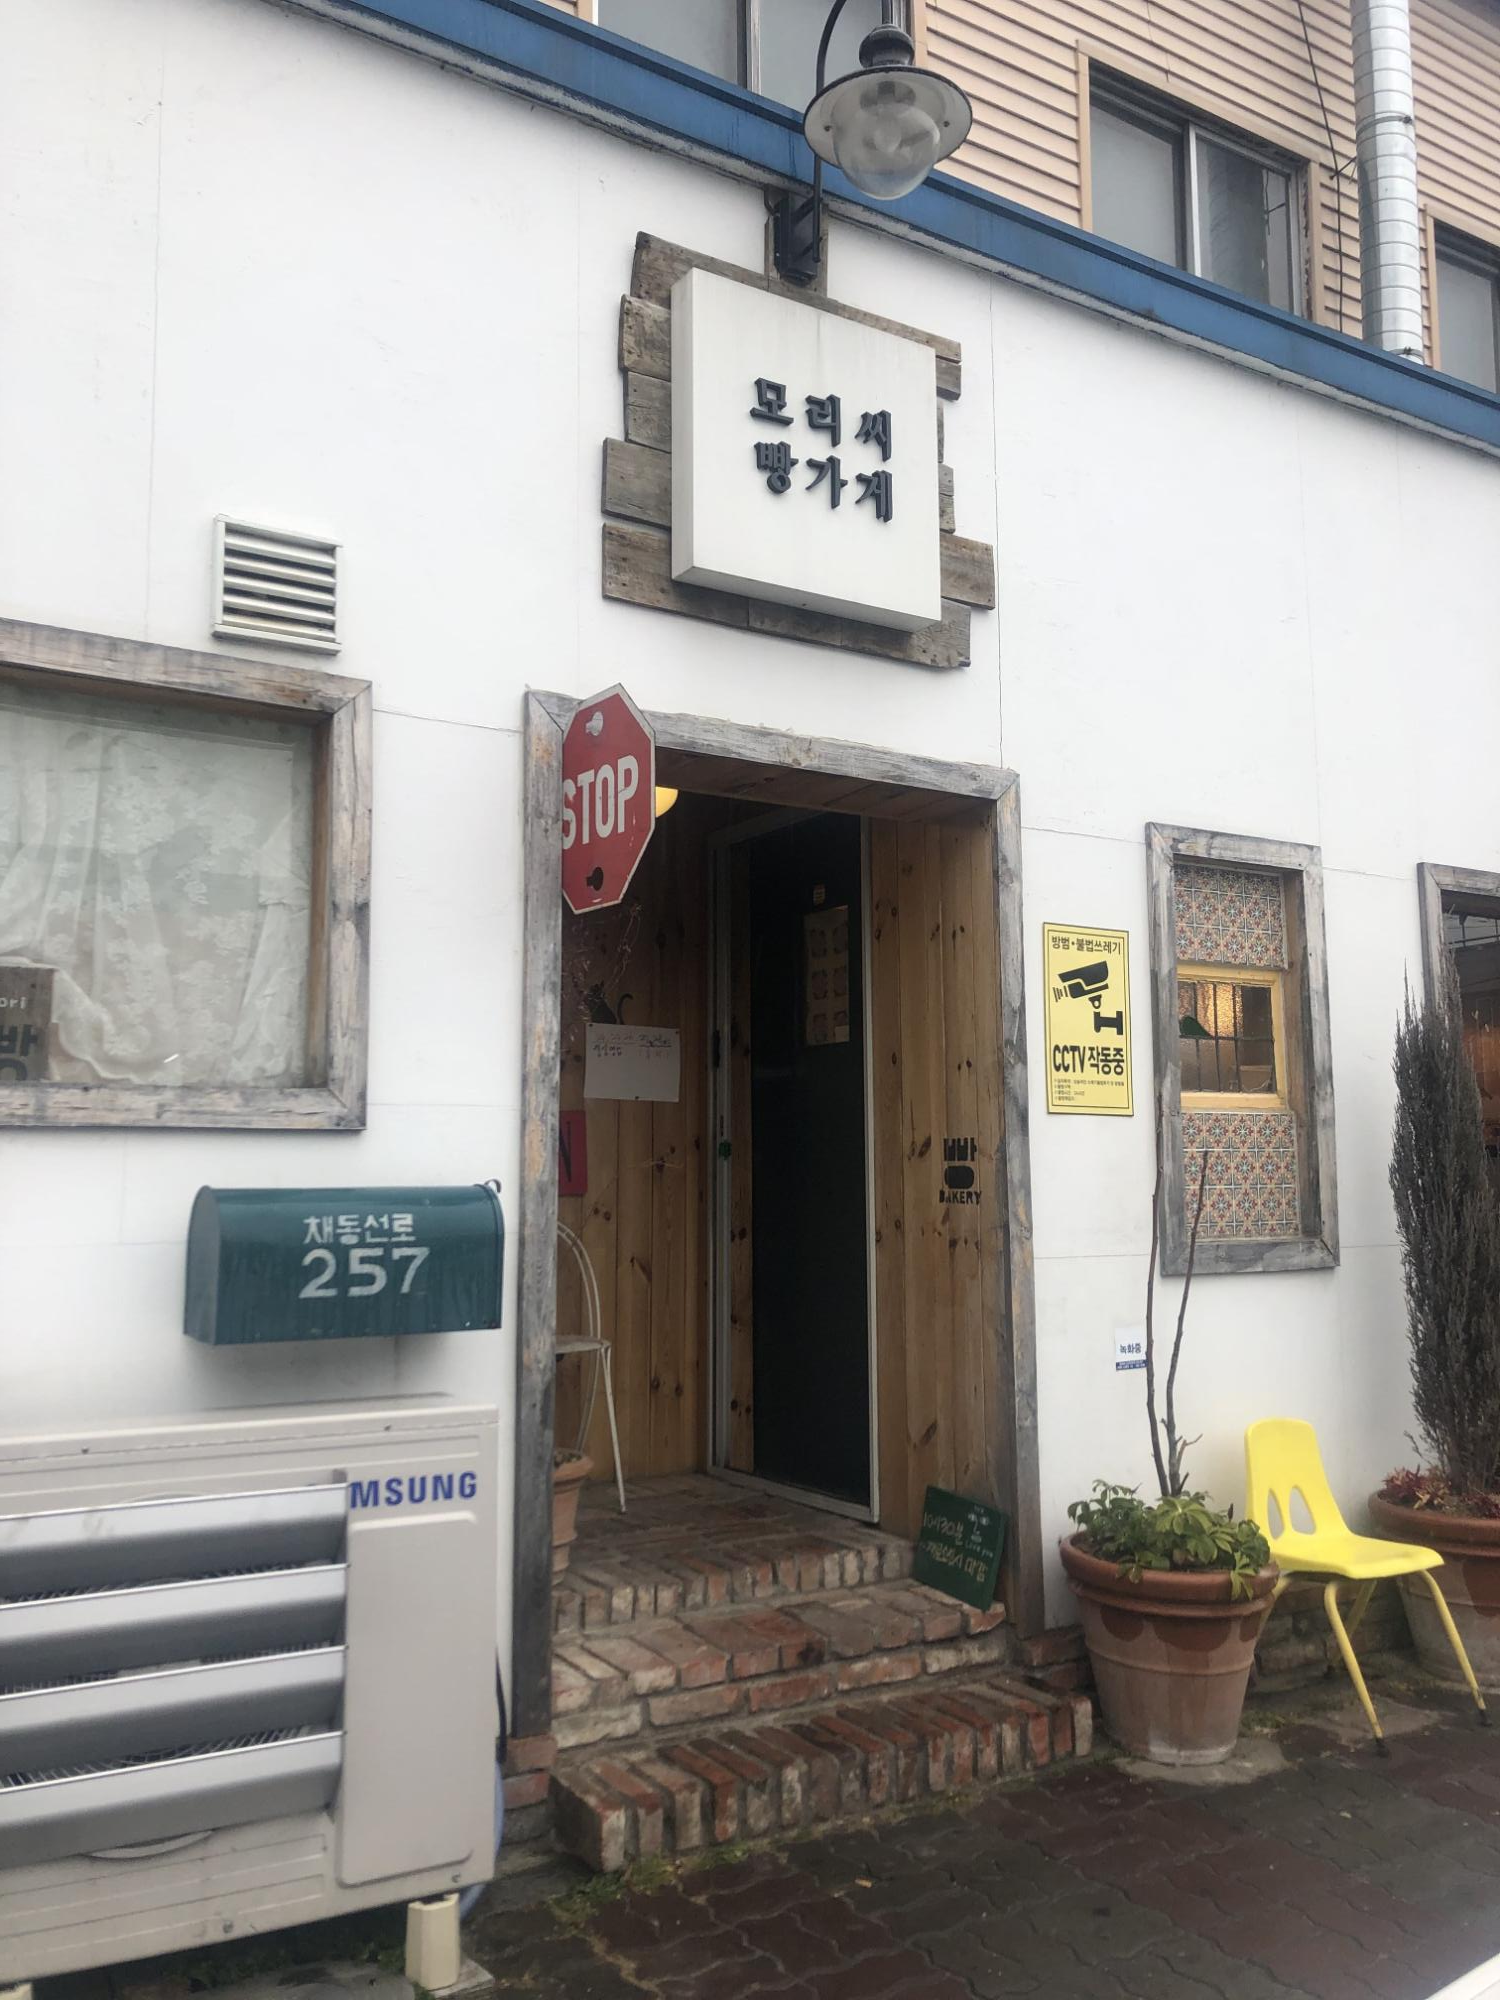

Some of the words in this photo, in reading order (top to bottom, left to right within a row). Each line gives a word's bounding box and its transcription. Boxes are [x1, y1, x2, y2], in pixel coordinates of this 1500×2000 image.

[750, 377, 892, 462] 모리씨
[754, 440, 893, 523] 빵가게
[562, 755, 639, 850] STOP
[1053, 1044, 1086, 1073] CCTV
[1087, 1045, 1125, 1076] 작동중
[939, 1190, 982, 1206] BAKERY
[303, 1213, 416, 1245] 채동선로
[299, 1247, 430, 1298] 257
[1119, 1342, 1141, 1354] 녹화중
